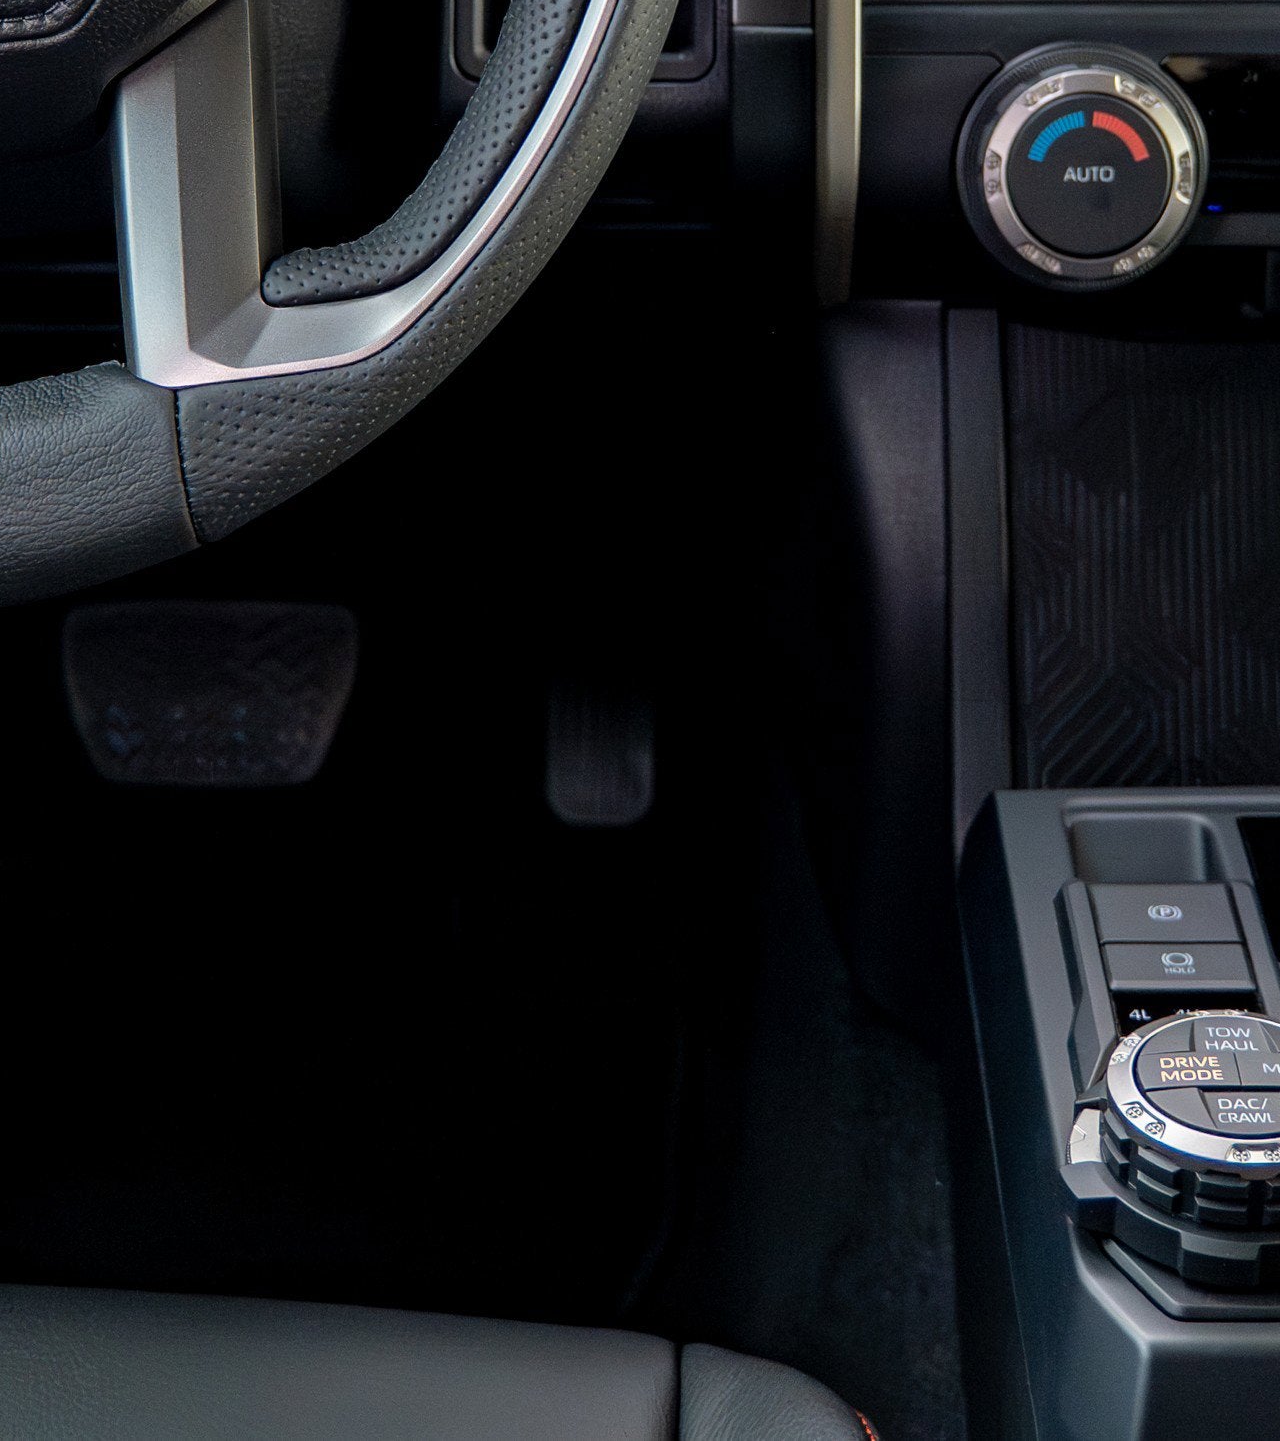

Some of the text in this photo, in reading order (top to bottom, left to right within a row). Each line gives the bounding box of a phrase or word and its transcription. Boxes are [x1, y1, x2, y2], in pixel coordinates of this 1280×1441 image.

[1062, 165, 1117, 184] AUTO
[1163, 966, 1196, 975] HOLD
[1128, 1008, 1152, 1022] 4L
[1206, 1026, 1251, 1038] TOW
[1204, 1039, 1260, 1052] HAUL
[1159, 1055, 1222, 1069] DRIVE
[1160, 1069, 1224, 1083] MODE
[1217, 1097, 1268, 1111] DAC/
[1217, 1111, 1276, 1125] CRAWL
